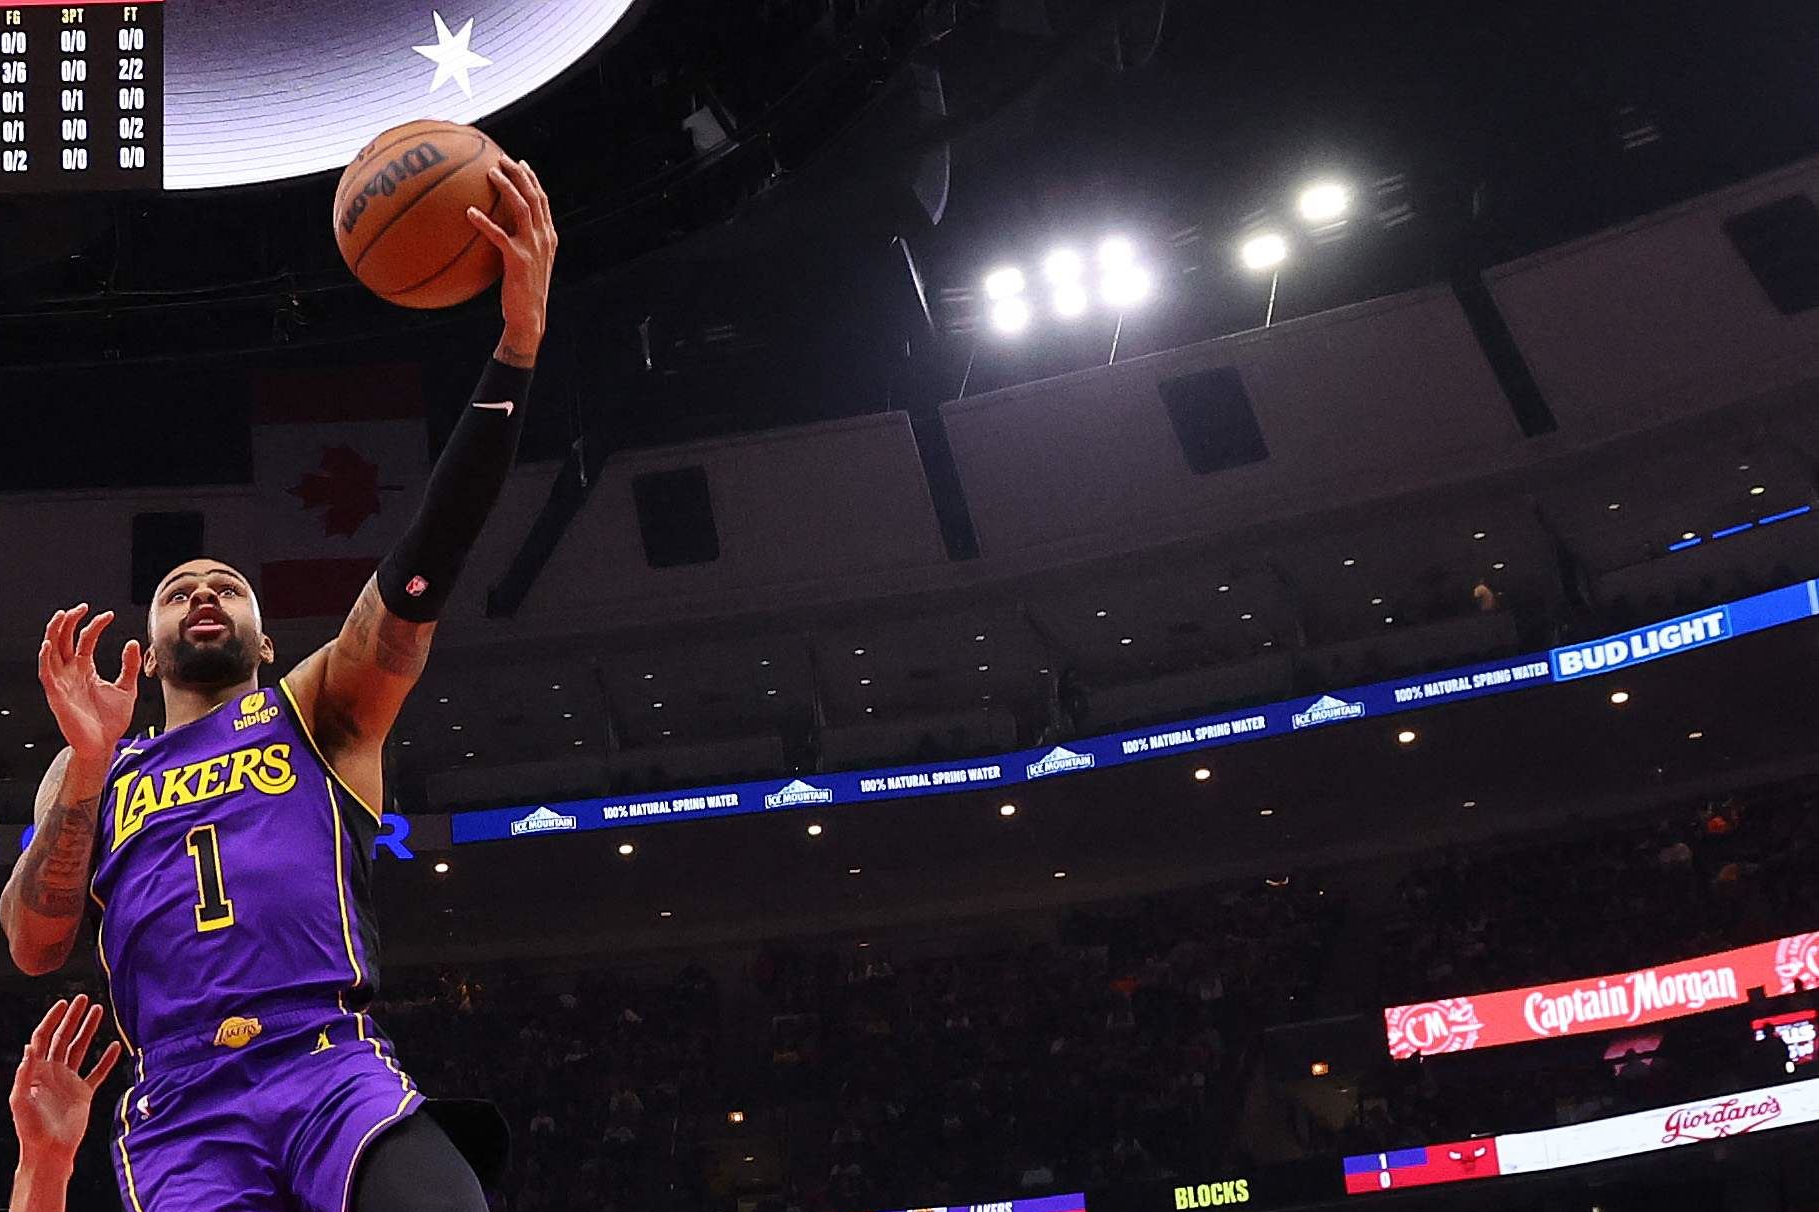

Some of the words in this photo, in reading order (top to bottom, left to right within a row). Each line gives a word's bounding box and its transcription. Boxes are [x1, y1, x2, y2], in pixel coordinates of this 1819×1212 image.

[6, 10, 20, 24] FG
[62, 8, 83, 23] 3PT
[124, 7, 138, 21] FT
[2, 32, 26, 54] 0/0
[61, 30, 86, 52] 0/0
[119, 28, 143, 50] 0/0
[2, 61, 26, 83] 3/6
[62, 60, 86, 82] 0/0
[119, 58, 143, 80] 2/2
[3, 91, 23, 113] 0/1
[62, 89, 83, 111] 0/1
[119, 87, 144, 109] 0/0
[3, 120, 24, 142] 0/1
[62, 118, 86, 141] 0/0
[120, 117, 143, 139] 0/2
[3, 150, 27, 171] 0/2
[63, 148, 87, 169] 0/0
[120, 146, 144, 168] 0/0
[1559, 640, 1628, 675] BUD
[1630, 612, 1724, 659] LIGHT
[1395, 686, 1423, 702] 100%
[1424, 677, 1472, 697] NATURAL
[1473, 669, 1511, 687] SPRING
[1512, 662, 1548, 680] WATER
[233, 704, 279, 732] bibigo
[1295, 714, 1310, 726] ICE
[1311, 704, 1362, 722] MOUNTAIN
[1123, 738, 1148, 754] 100%
[1150, 730, 1194, 749] NATURAL
[1195, 723, 1230, 740] SPRING
[1231, 716, 1265, 733] WATER
[861, 779, 886, 792] 100%
[888, 774, 931, 789] NATURAL
[932, 770, 966, 784] SPRING
[968, 766, 1000, 781] WATER
[111, 743, 297, 853] LAKERS
[604, 806, 628, 819] 100%
[629, 801, 671, 816] NATURAL
[673, 798, 705, 811] SPRING
[707, 794, 738, 808] WATER
[514, 821, 528, 832] ICE
[528, 817, 573, 830] MOUNTAIN
[187, 823, 235, 933] 1
[1524, 980, 1631, 1036] Captain
[1627, 966, 1738, 1022] Morgan
[1661, 1095, 1783, 1144] Giordano's
[1175, 1178, 1249, 1211] BLOCKS
